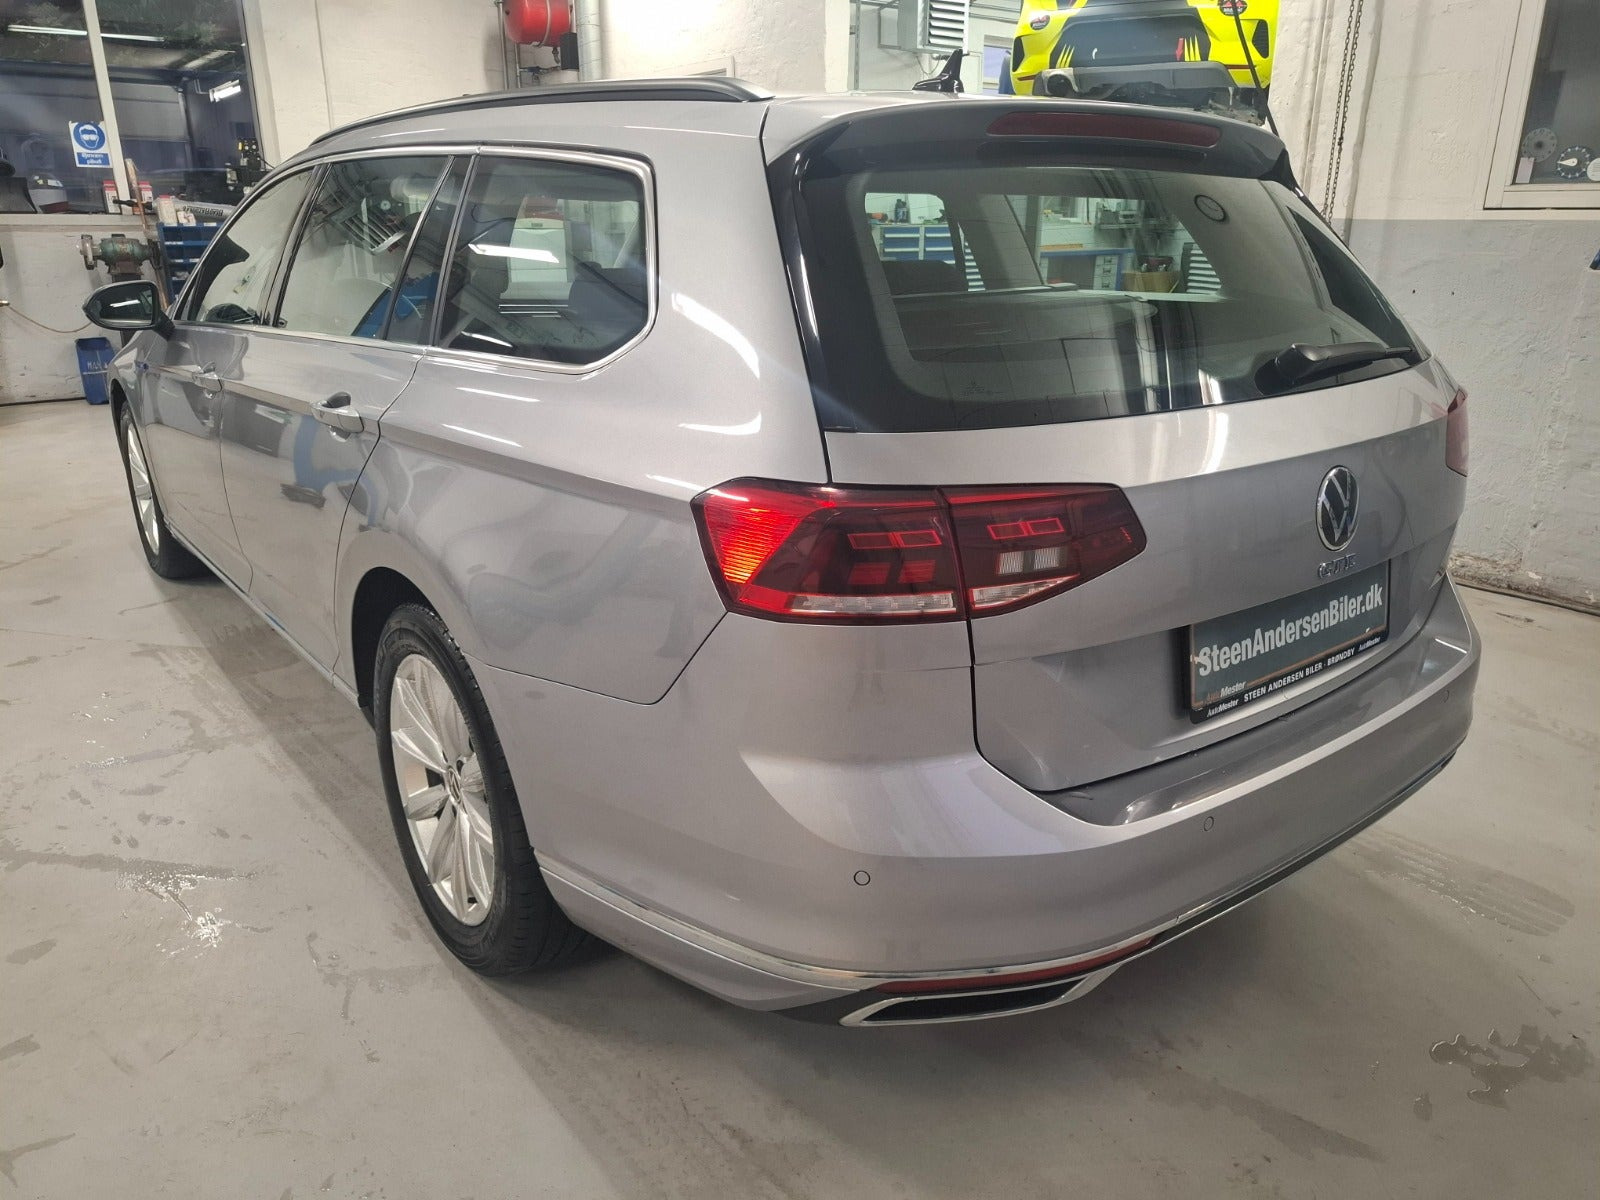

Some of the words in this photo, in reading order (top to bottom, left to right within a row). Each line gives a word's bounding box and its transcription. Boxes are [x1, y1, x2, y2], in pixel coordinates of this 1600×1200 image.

[1318, 553, 1358, 578] GTE
[1199, 583, 1383, 677] SteenAndersenBiler.dk
[1244, 686, 1267, 702] STEEN
[1267, 670, 1304, 693] ANDERSEN
[1305, 662, 1323, 676] BILER
[1327, 647, 1355, 666] BRØNDBY
